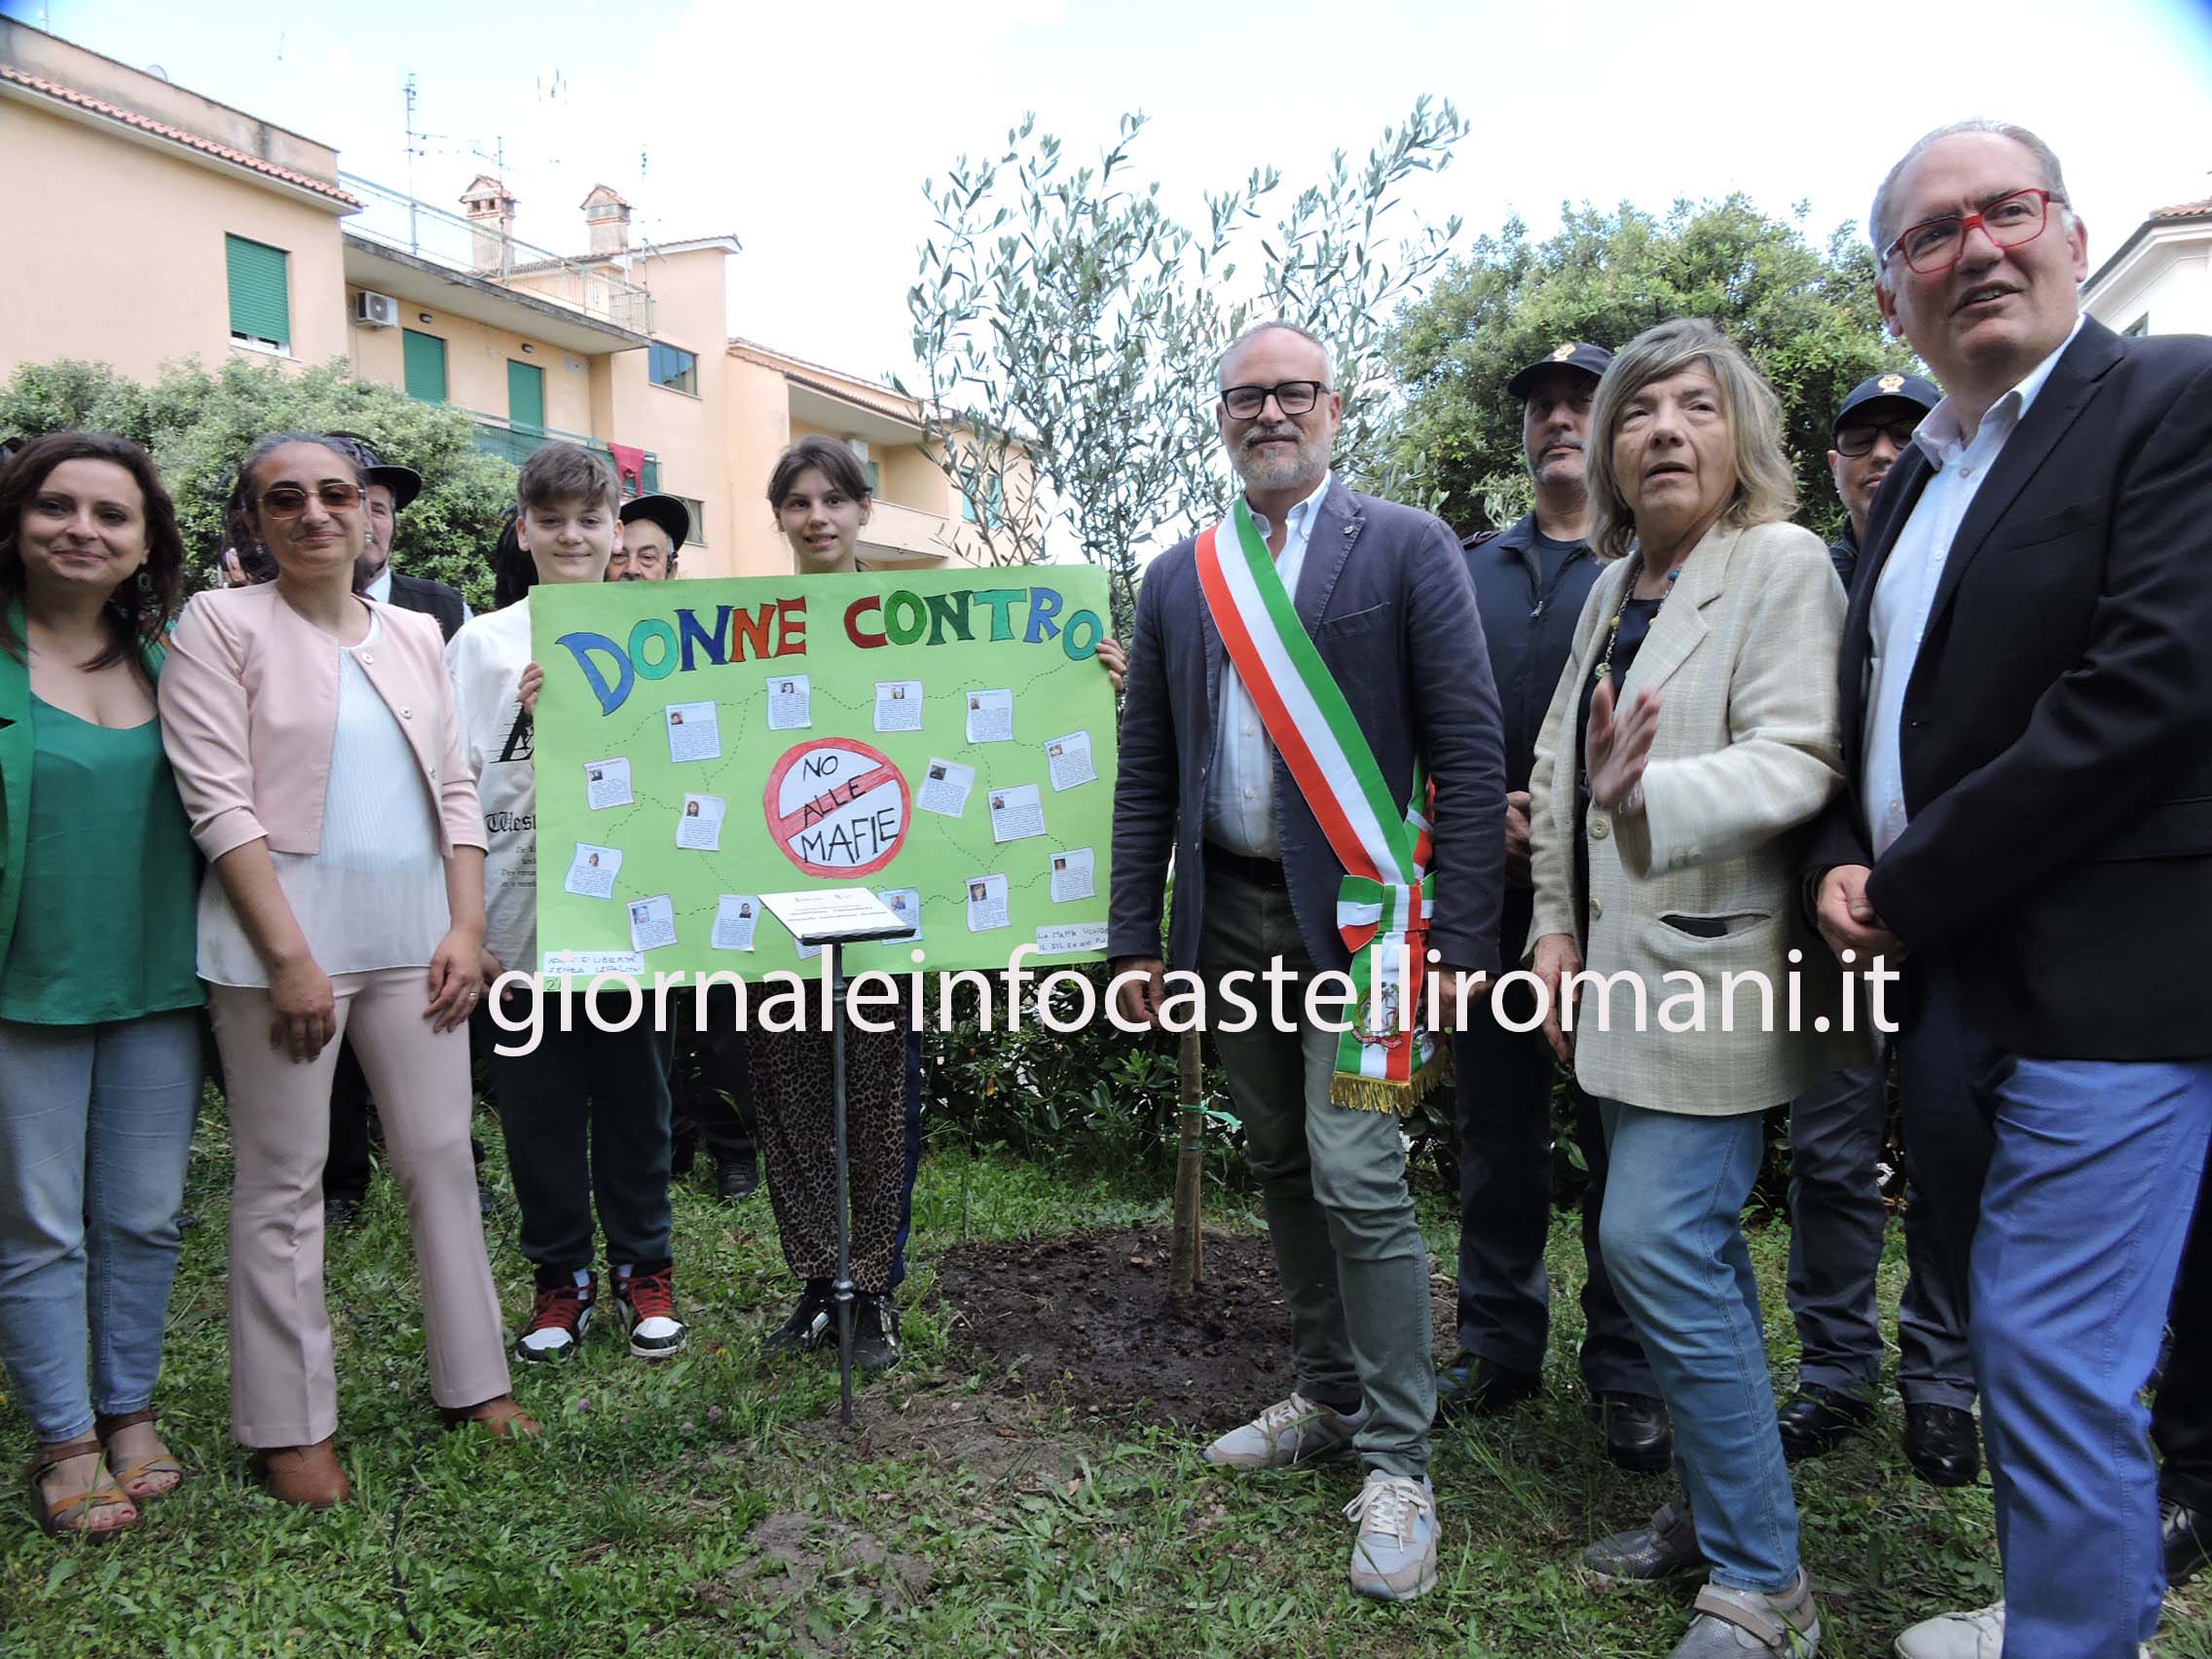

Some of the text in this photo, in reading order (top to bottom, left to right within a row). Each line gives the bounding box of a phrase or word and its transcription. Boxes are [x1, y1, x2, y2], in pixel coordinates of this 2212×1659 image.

[554, 596, 807, 717] DONNE
[843, 587, 1104, 661] CONTRO
[803, 756, 838, 781] NO
[803, 775, 866, 829] ALLE
[800, 807, 899, 864] MAFIE
